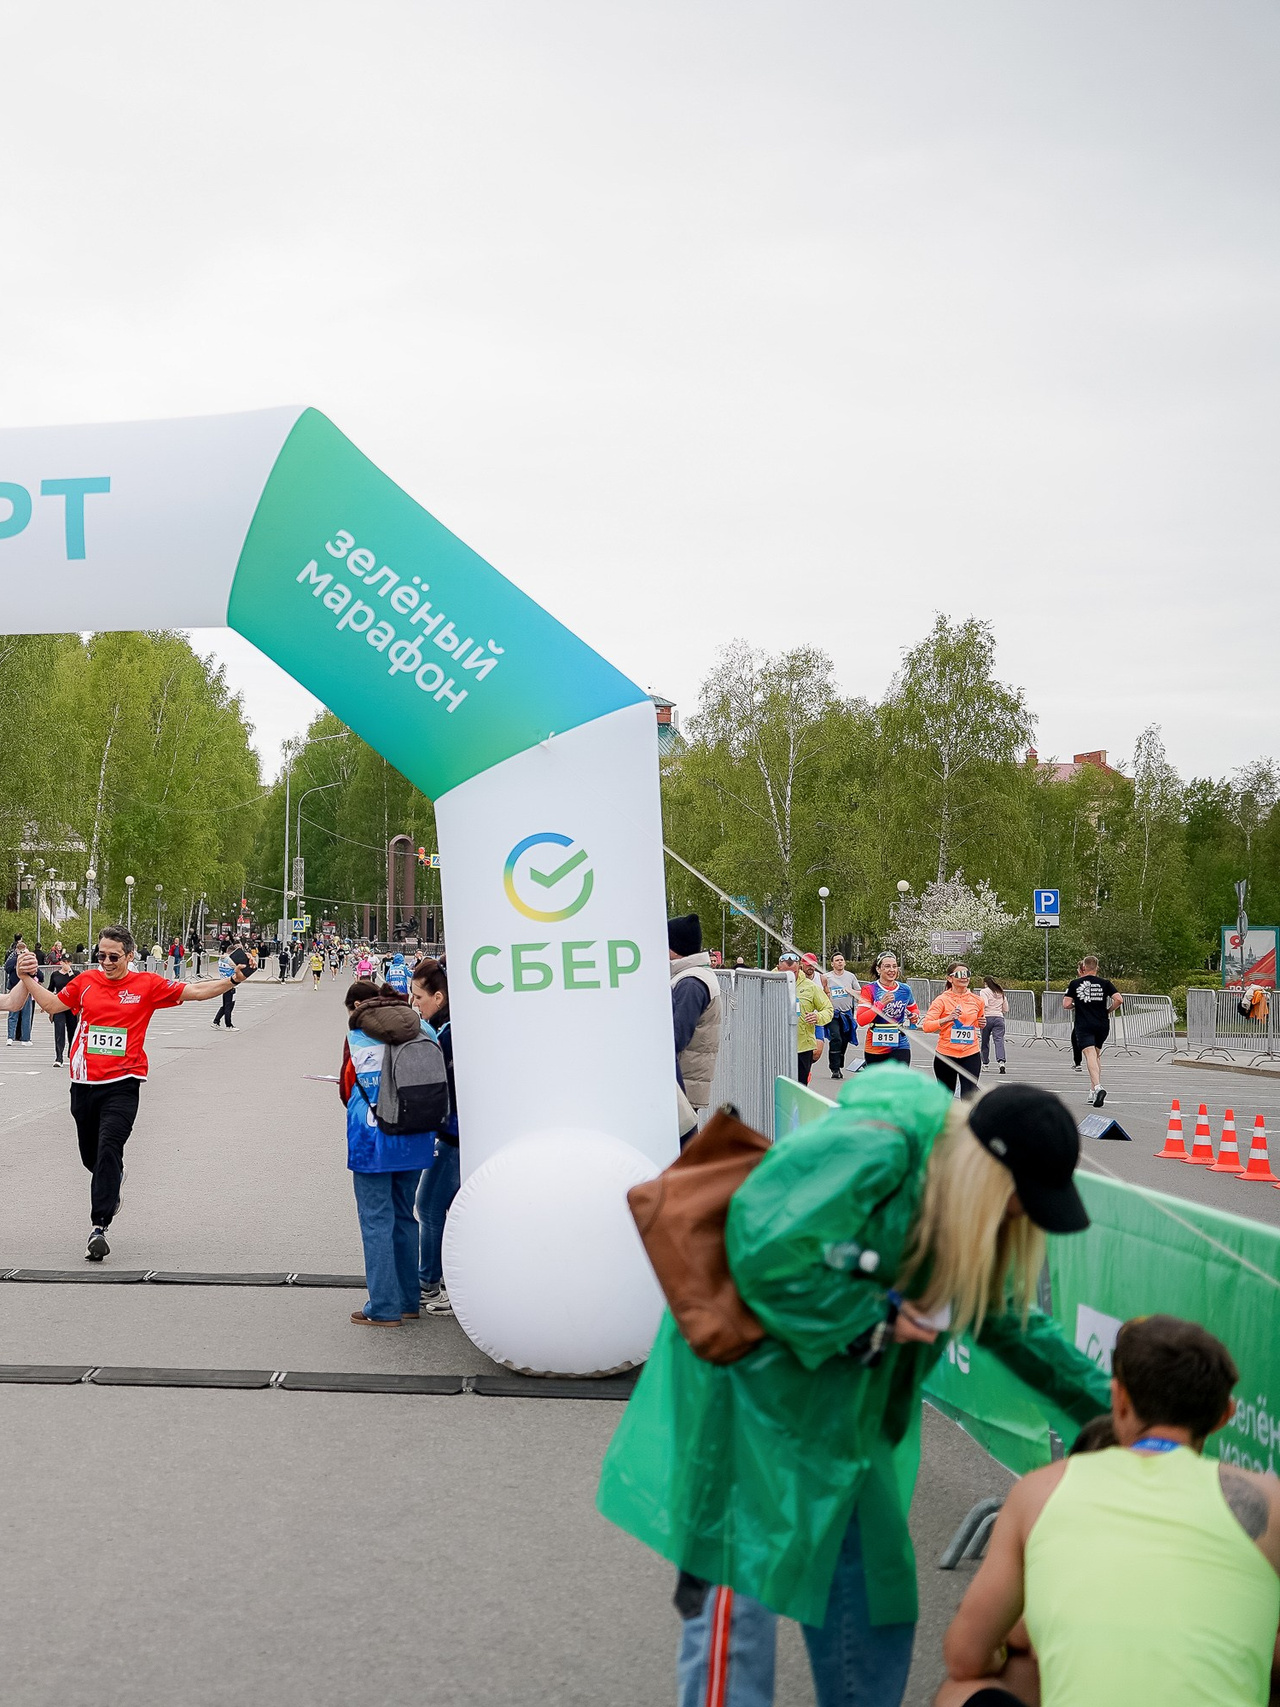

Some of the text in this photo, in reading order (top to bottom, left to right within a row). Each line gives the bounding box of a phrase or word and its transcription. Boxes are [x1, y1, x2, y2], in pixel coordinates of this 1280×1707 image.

[324, 529, 506, 682] зелёный
[296, 559, 469, 714] марафон
[1041, 892, 1055, 912] P
[469, 939, 641, 995] СБЕР
[92, 1034, 123, 1047] 1512
[877, 1033, 894, 1042] 815
[955, 1030, 971, 1039] 790
